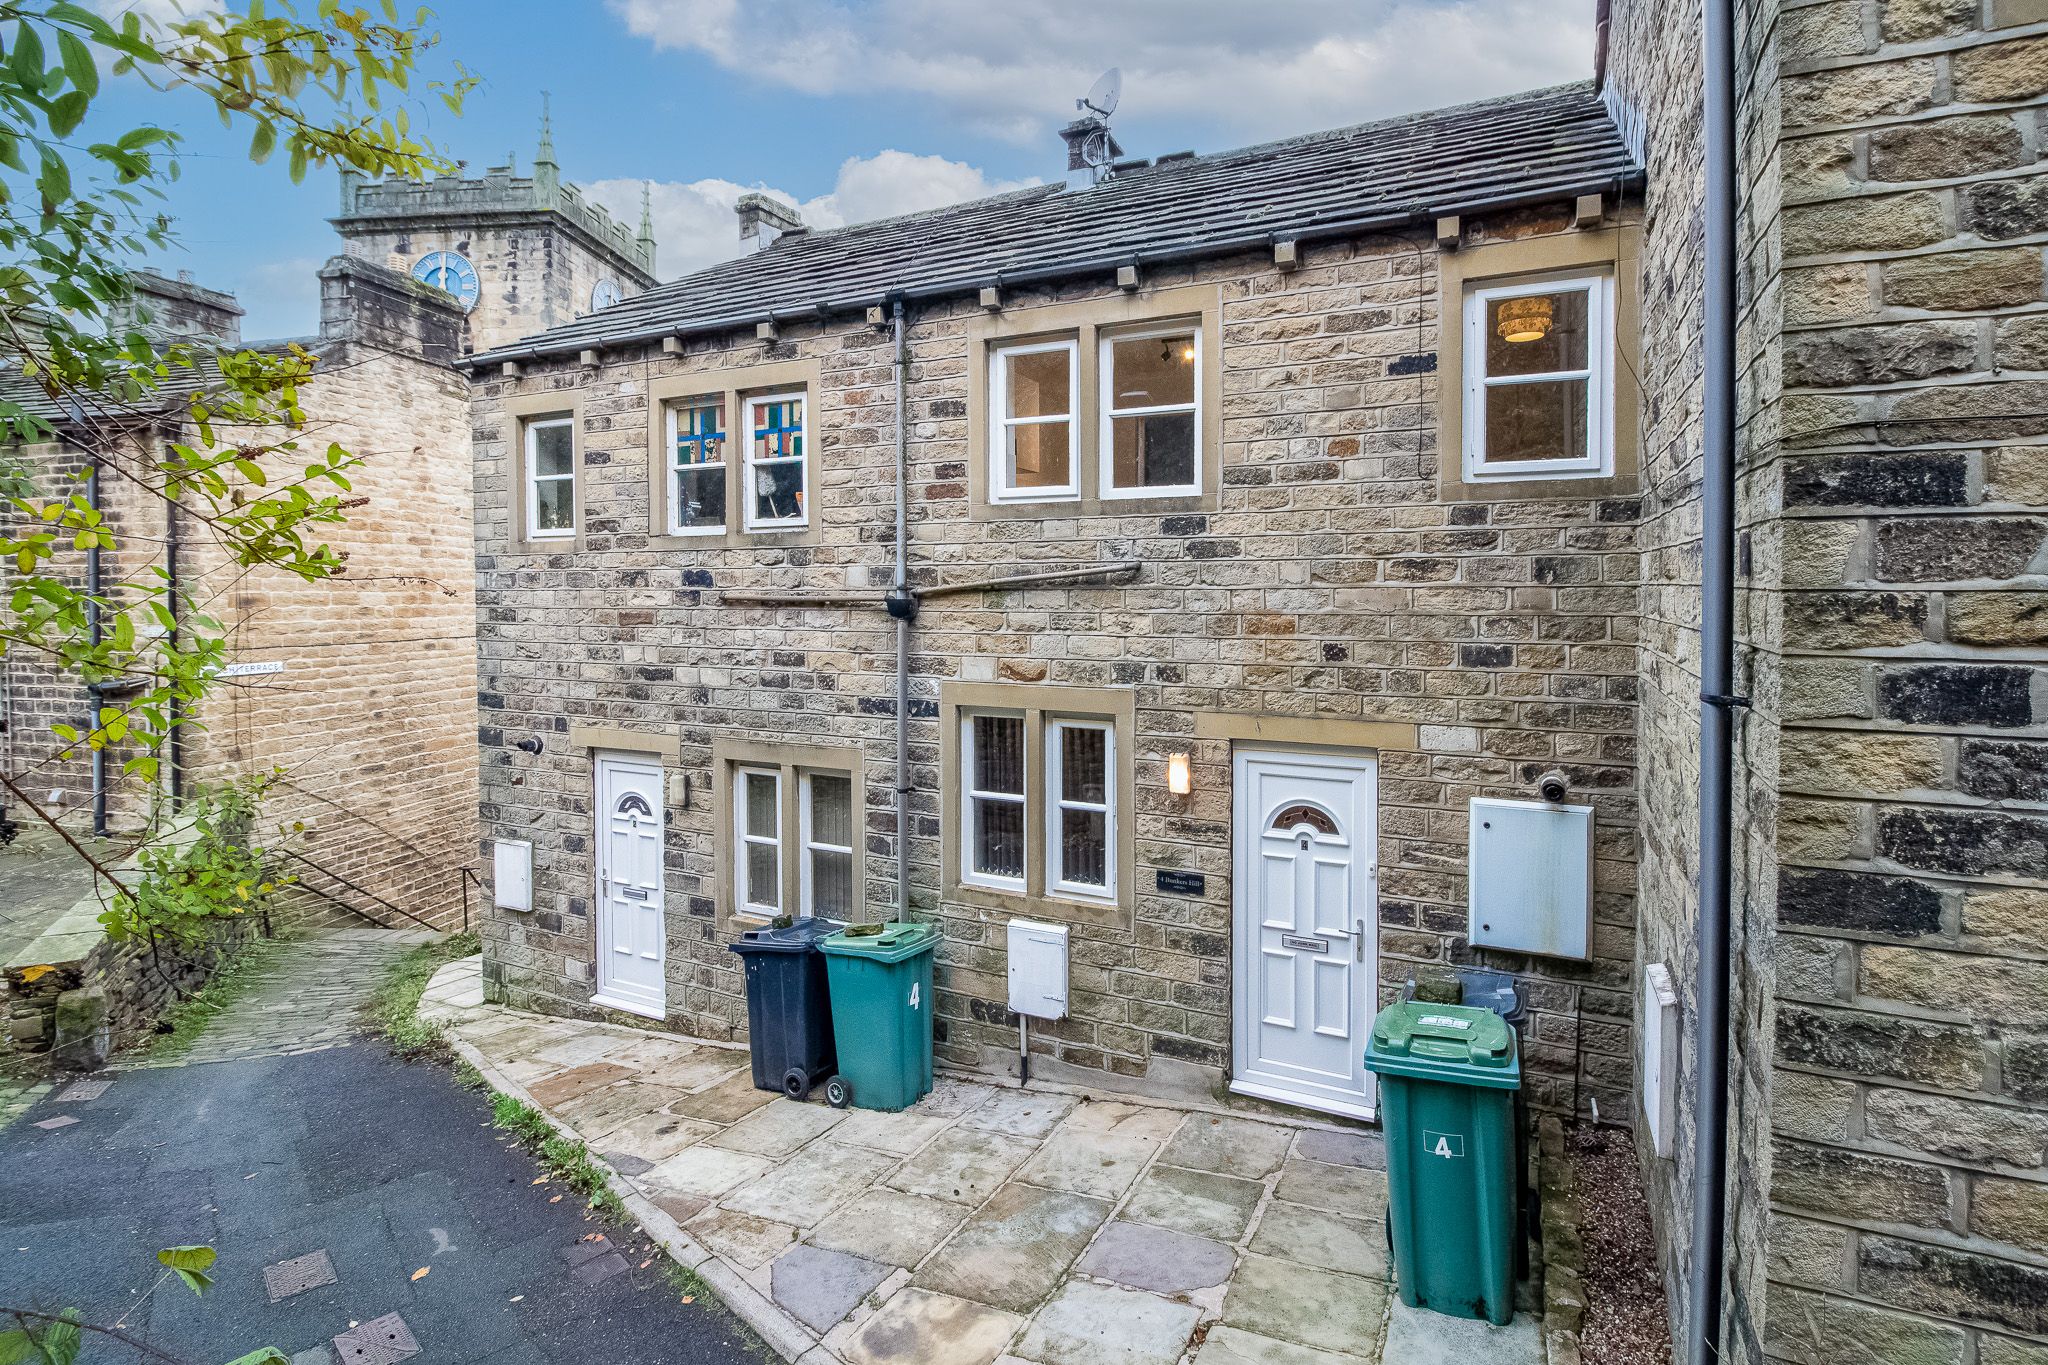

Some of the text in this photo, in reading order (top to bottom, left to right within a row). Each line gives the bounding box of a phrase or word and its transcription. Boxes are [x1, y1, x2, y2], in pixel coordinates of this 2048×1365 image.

[238, 663, 279, 674] TERRACE
[1188, 879, 1200, 887] Hill
[909, 981, 920, 1010] 4
[1435, 1136, 1452, 1159] 4
